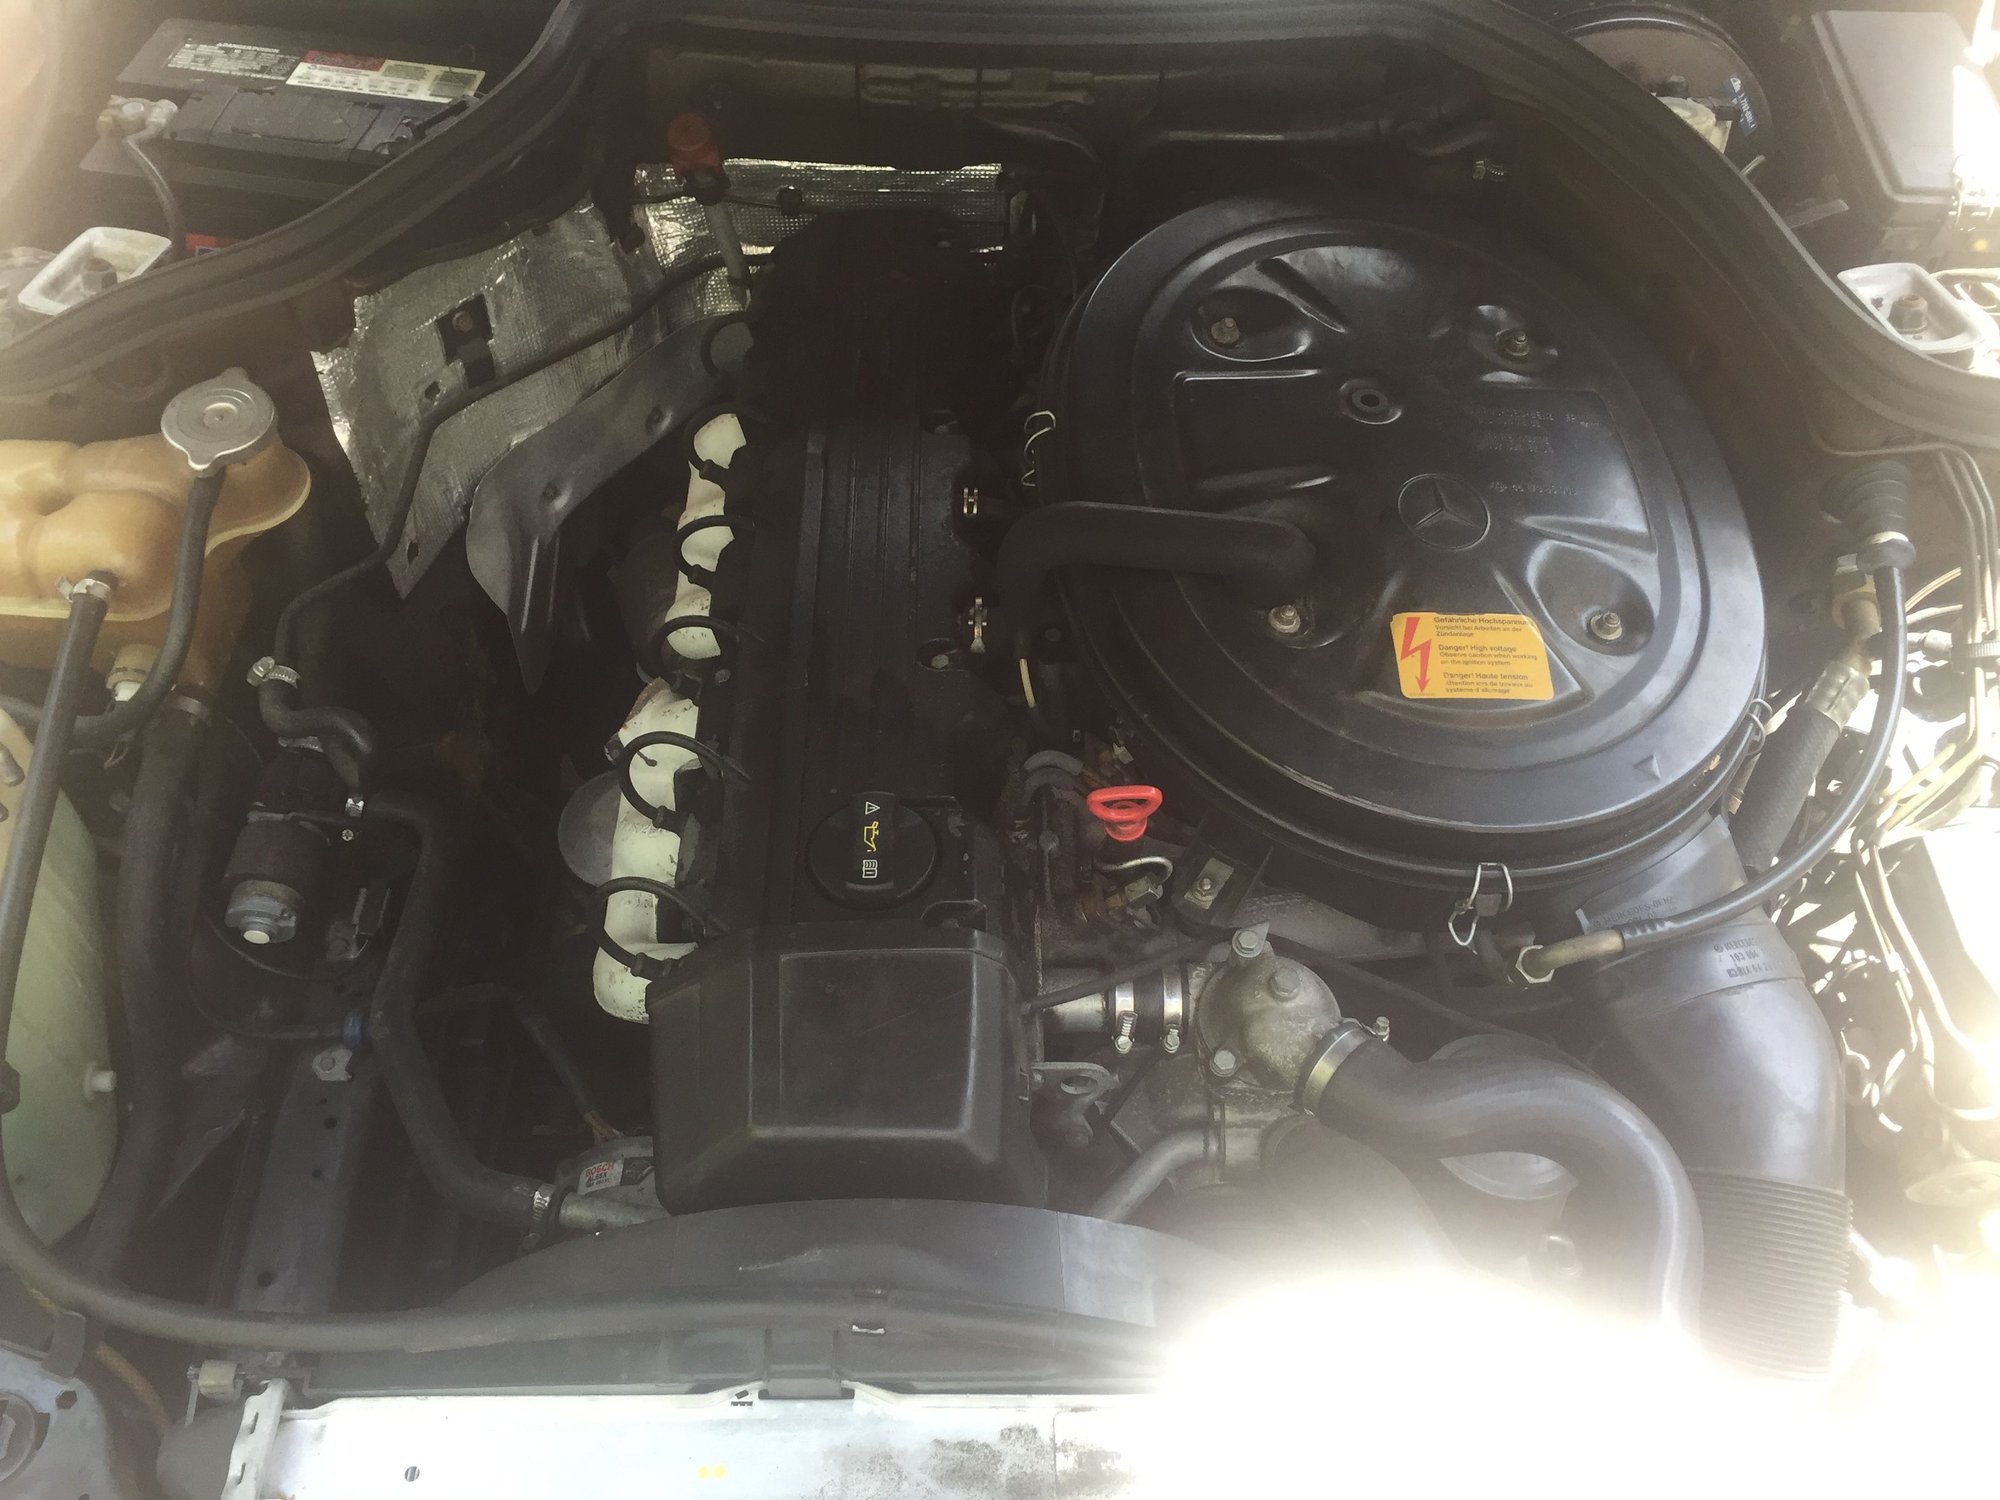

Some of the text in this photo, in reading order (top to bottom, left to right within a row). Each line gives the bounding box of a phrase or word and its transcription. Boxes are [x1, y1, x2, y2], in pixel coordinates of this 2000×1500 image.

[1438, 644, 1517, 654] Danger! High voltage
[1443, 672, 1528, 681] Danger! Haute tension
[585, 1161, 614, 1178] BOSCH
